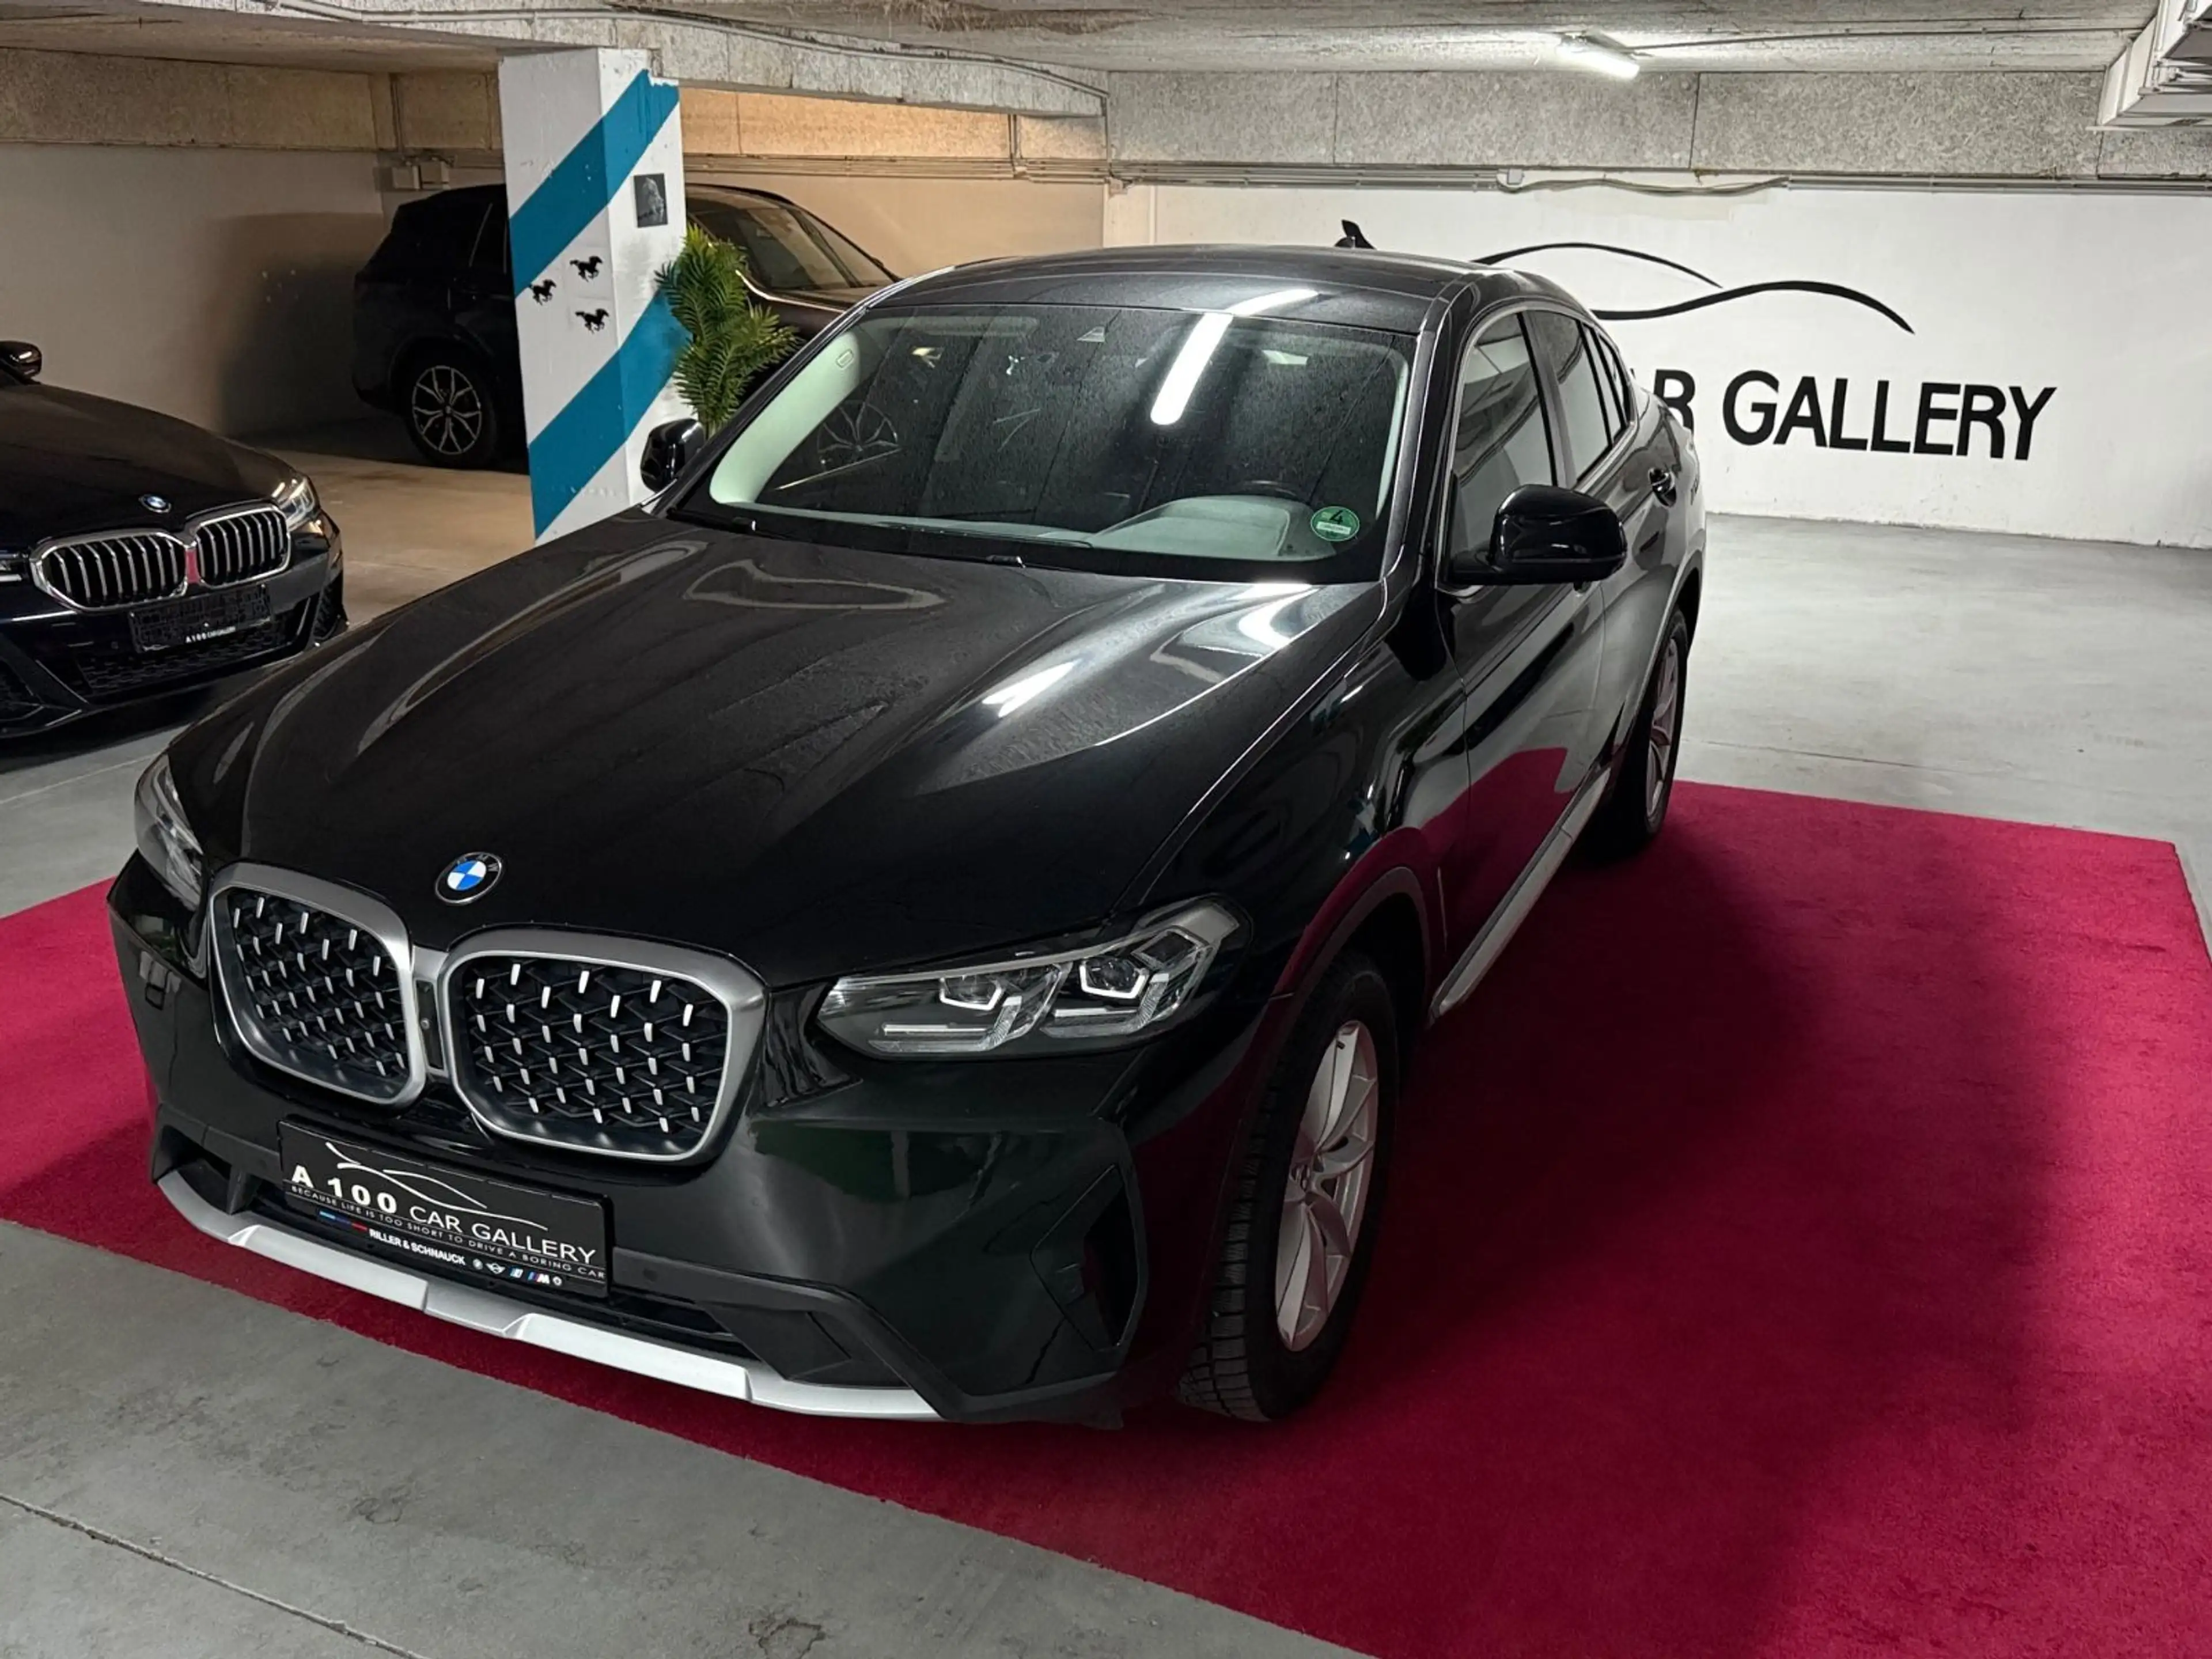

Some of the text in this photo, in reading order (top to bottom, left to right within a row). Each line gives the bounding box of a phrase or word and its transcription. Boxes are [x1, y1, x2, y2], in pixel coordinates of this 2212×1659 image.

[1723, 369, 2057, 461] GALLERY
[1329, 510, 1343, 524] 4
[291, 1165, 596, 1264] A 100 CAR GALLERY
[291, 1185, 337, 1206] BECAUSE
[341, 1202, 362, 1215] LIFE
[366, 1210, 376, 1218] IS
[380, 1214, 403, 1227] TOO
[407, 1222, 444, 1238] SHORT
[448, 1233, 463, 1244] TO
[468, 1240, 503, 1255] DRIVE
[522, 1255, 572, 1271] BORING
[578, 1266, 605, 1279] CAR
[402, 1240, 410, 1249] &
[411, 1242, 466, 1266] SCHNAUCK
